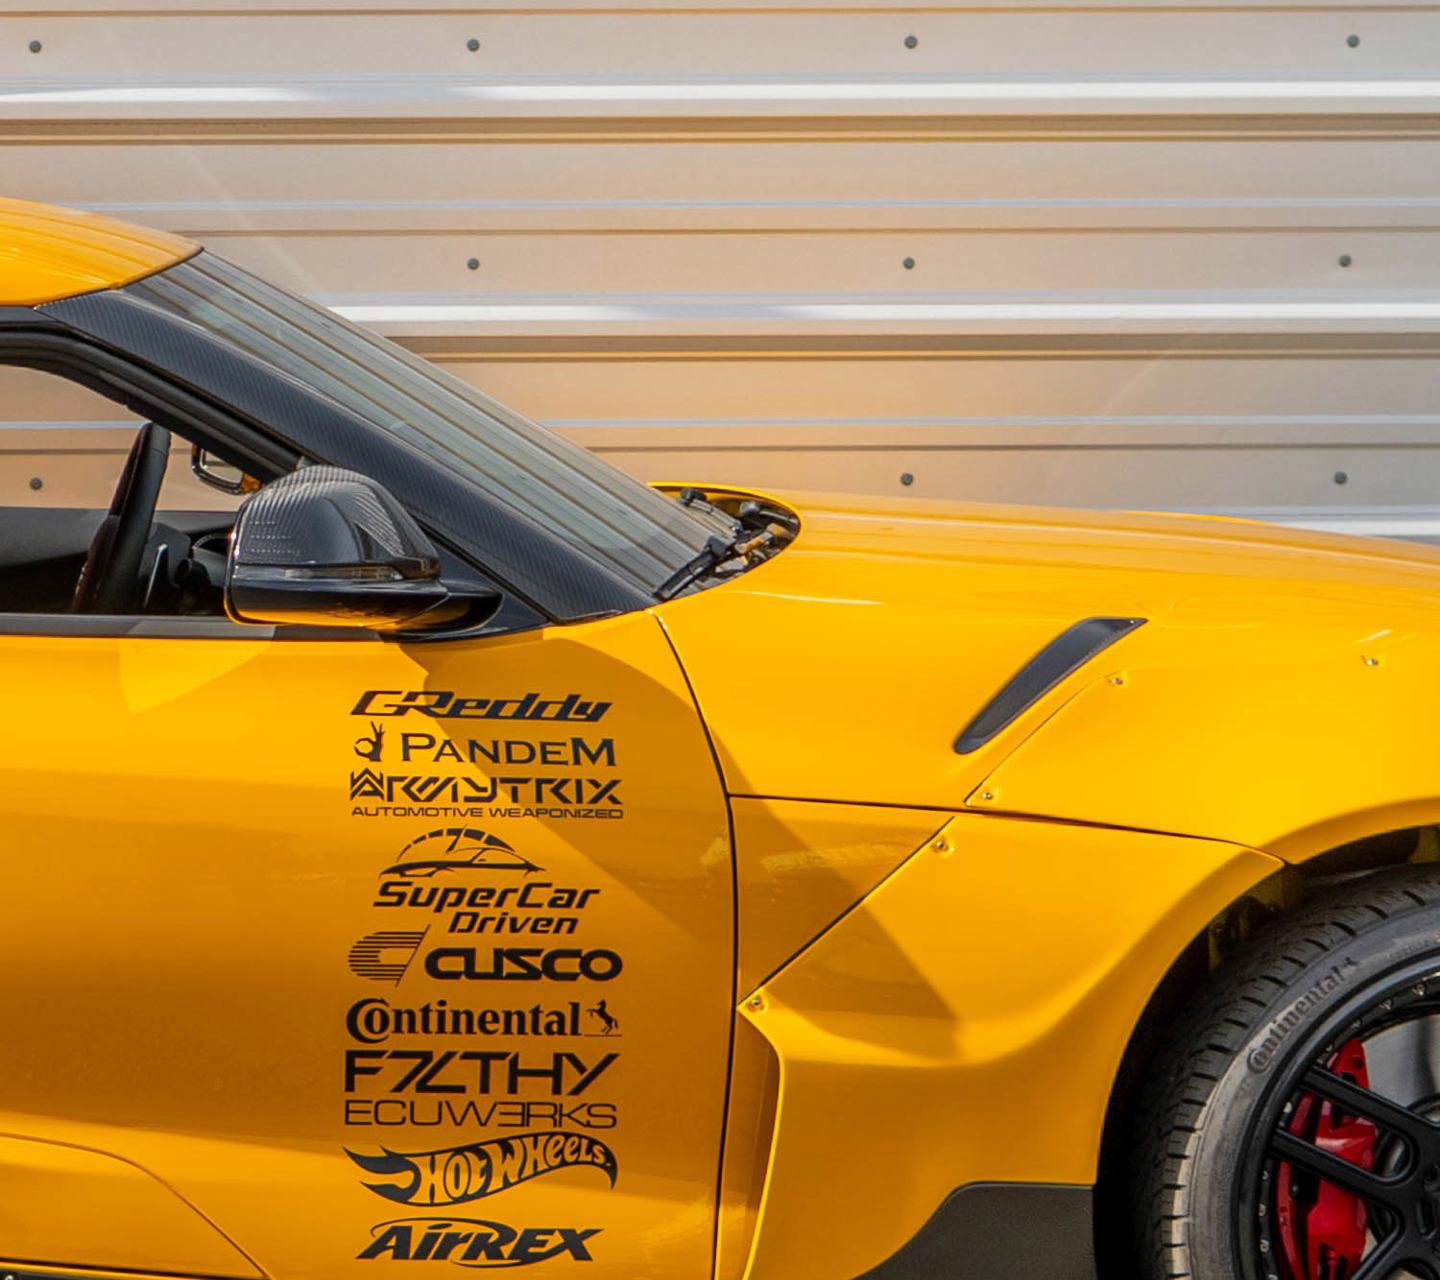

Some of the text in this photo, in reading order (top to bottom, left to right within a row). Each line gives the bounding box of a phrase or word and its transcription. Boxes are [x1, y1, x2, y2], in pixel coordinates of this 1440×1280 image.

[350, 690, 613, 722] GReddy
[400, 732, 617, 766] PANDEM
[349, 767, 623, 805] ARMYTRIX
[351, 806, 624, 819] AUTOMOTIVE WEAPONIZED
[373, 881, 602, 913] SuperCar
[447, 912, 579, 934] Driven
[424, 947, 623, 981] CUSCO
[346, 997, 582, 1044] Continental
[1246, 965, 1344, 1074] Continental
